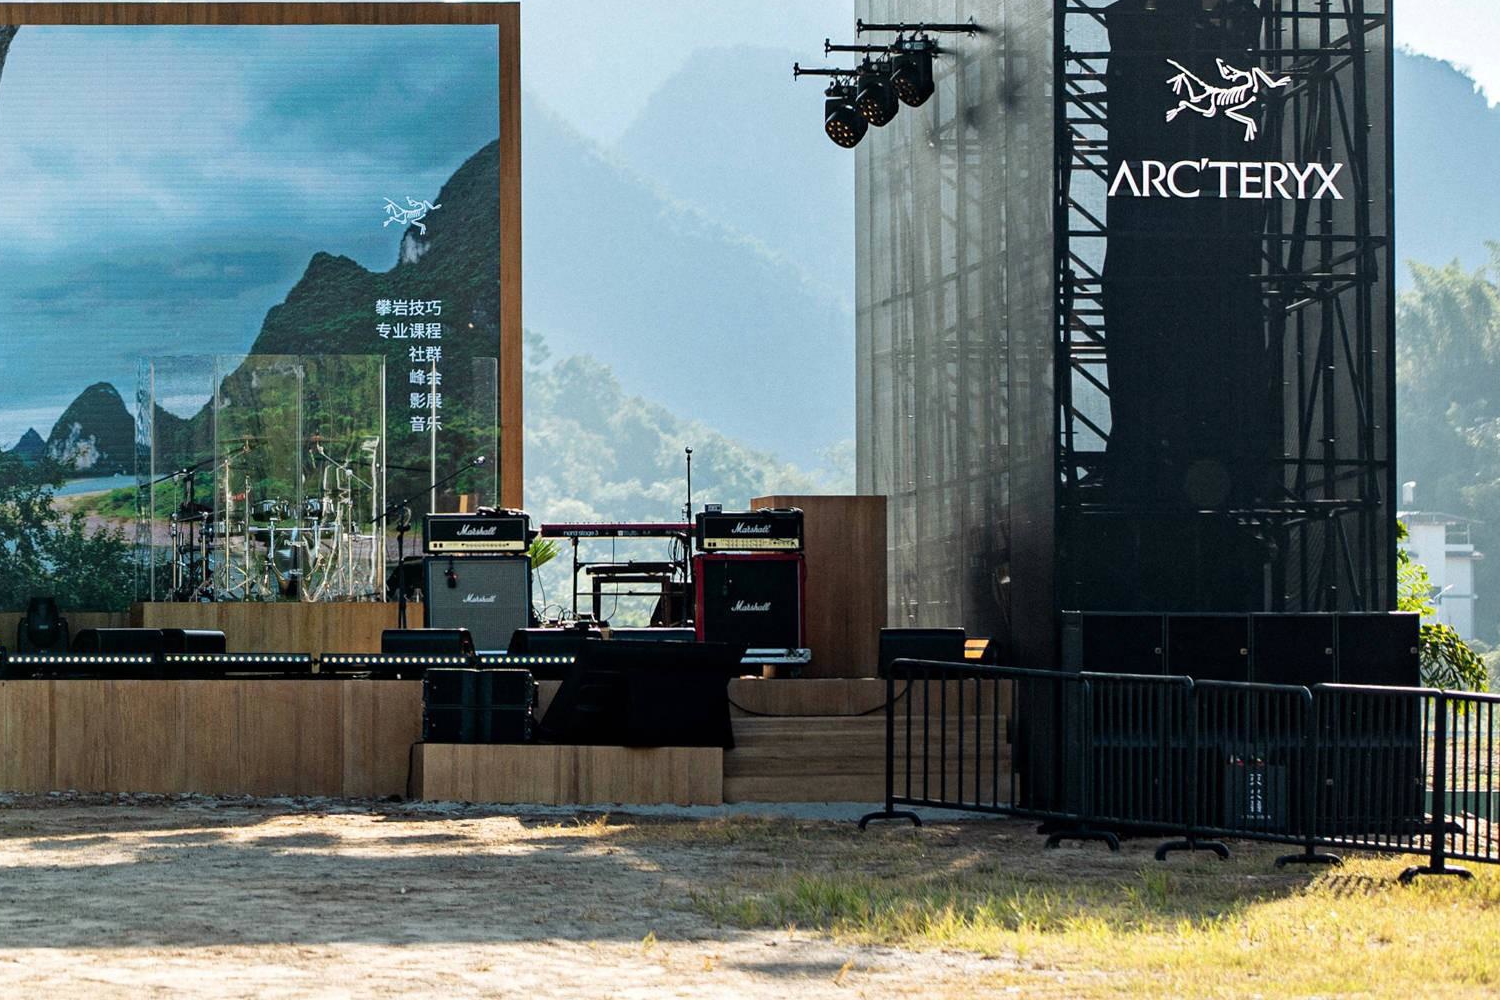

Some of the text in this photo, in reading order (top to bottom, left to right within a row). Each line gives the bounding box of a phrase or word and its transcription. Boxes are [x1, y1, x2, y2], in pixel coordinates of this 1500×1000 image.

[1107, 157, 1344, 200] ARC'TERYX
[375, 299, 442, 316] 攀岩技巧
[375, 323, 442, 339] 专业课程
[408, 346, 442, 362] 社群
[409, 369, 442, 386] 峰会
[409, 393, 442, 409] 影展
[409, 416, 443, 432] 音乐
[456, 524, 498, 536] Marshall
[731, 522, 772, 534] Marshall
[462, 592, 497, 603] Marshall
[731, 600, 772, 612] Marshall
